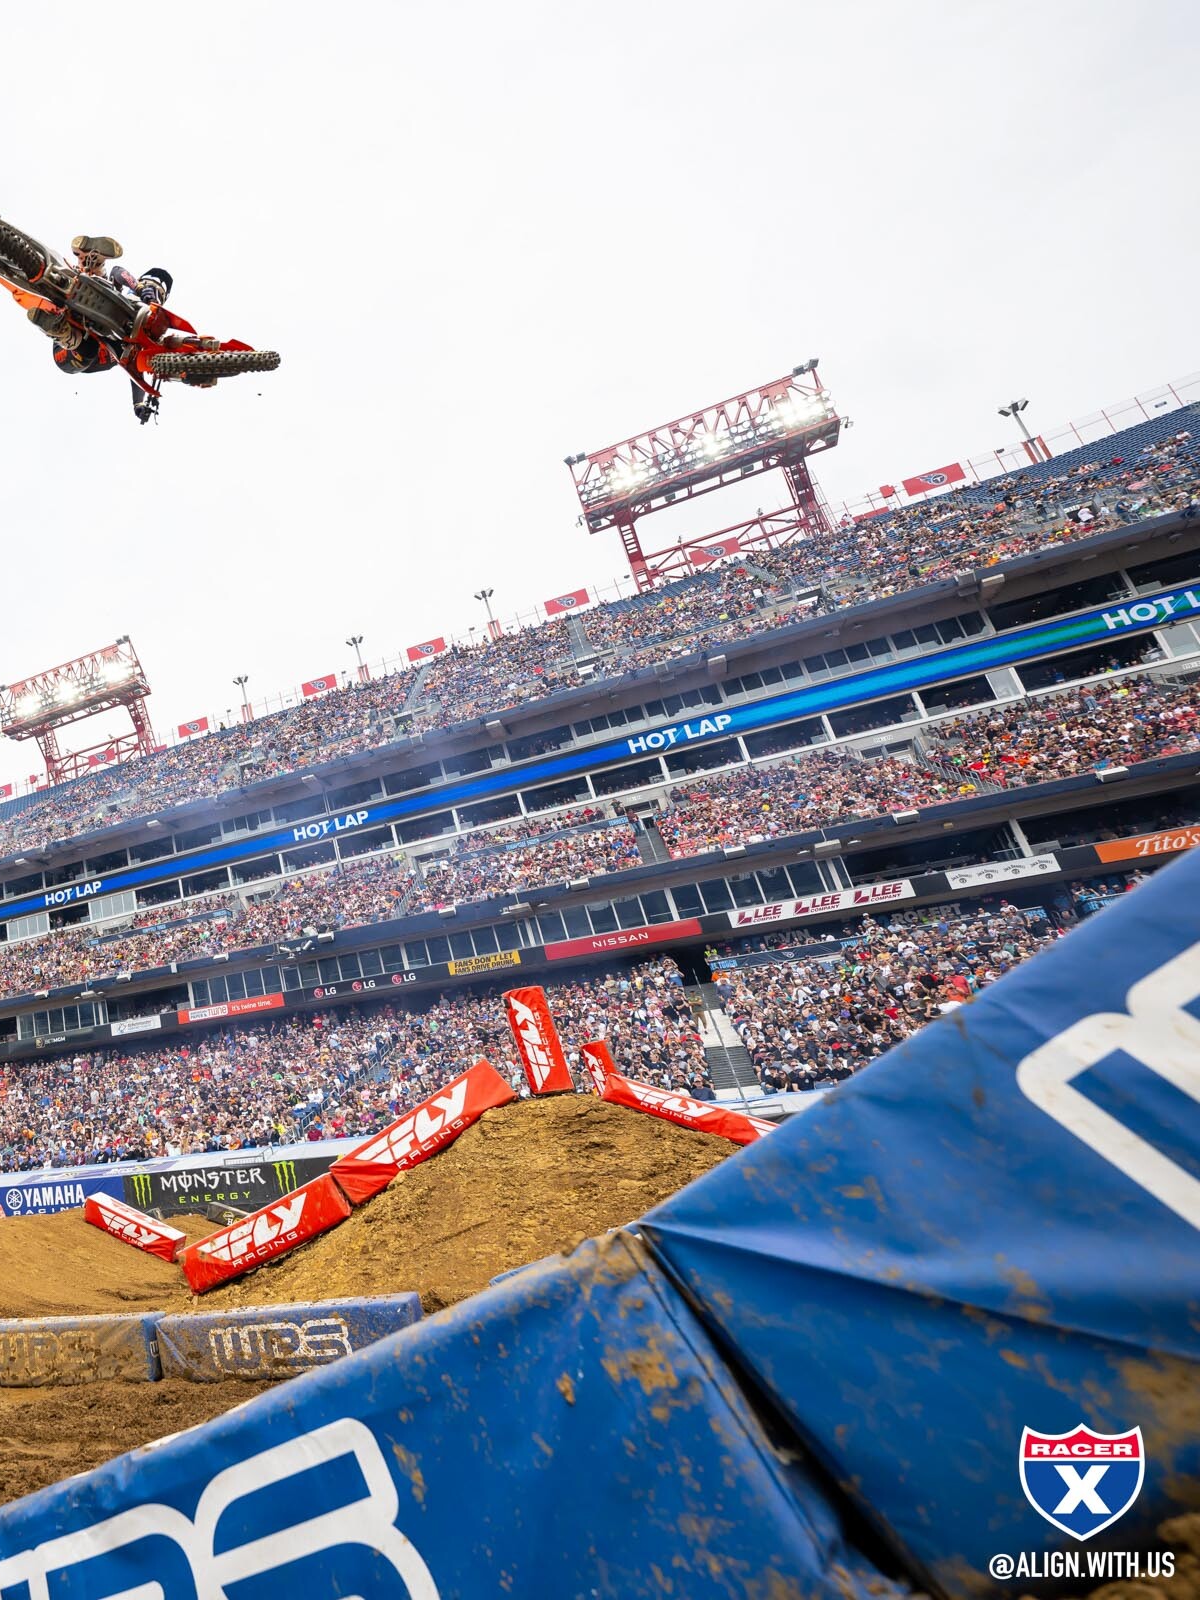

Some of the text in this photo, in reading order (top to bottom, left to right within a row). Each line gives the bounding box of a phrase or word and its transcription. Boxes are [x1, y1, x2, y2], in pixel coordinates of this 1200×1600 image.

[1102, 596, 1174, 630] HOT
[628, 714, 731, 754] HOT LAP
[294, 810, 369, 840] HOT LAP
[1136, 830, 1200, 855] Tito's
[45, 881, 102, 906] HOT LAP
[810, 893, 841, 908] LEE
[871, 893, 901, 902] COMPANY
[872, 882, 902, 897] LEE
[753, 915, 781, 923] COMPANY
[754, 904, 782, 918] LEE
[810, 904, 839, 913] COMPANY
[592, 932, 649, 948] NISSAN
[454, 952, 513, 968] FANS DON'T LET
[455, 959, 515, 974] FANS DRIVE DRUNK
[363, 980, 375, 989] LG
[403, 973, 416, 982] LG
[325, 987, 336, 995] LG
[510, 996, 550, 1091] FLY
[535, 1011, 556, 1067] RACING
[626, 1081, 715, 1117] FLY
[640, 1101, 693, 1122] RACING
[355, 1078, 468, 1164] FLY
[396, 1118, 465, 1169] RACING
[160, 1168, 266, 1193] MONSTER
[23, 1183, 85, 1208] YAMAHA
[179, 1191, 250, 1204] ENERGY
[98, 1207, 161, 1245] FLY
[108, 1227, 144, 1247] RACING
[196, 1192, 307, 1261] FLY
[232, 1232, 298, 1268] RACING
[209, 1317, 353, 1376] WPS
